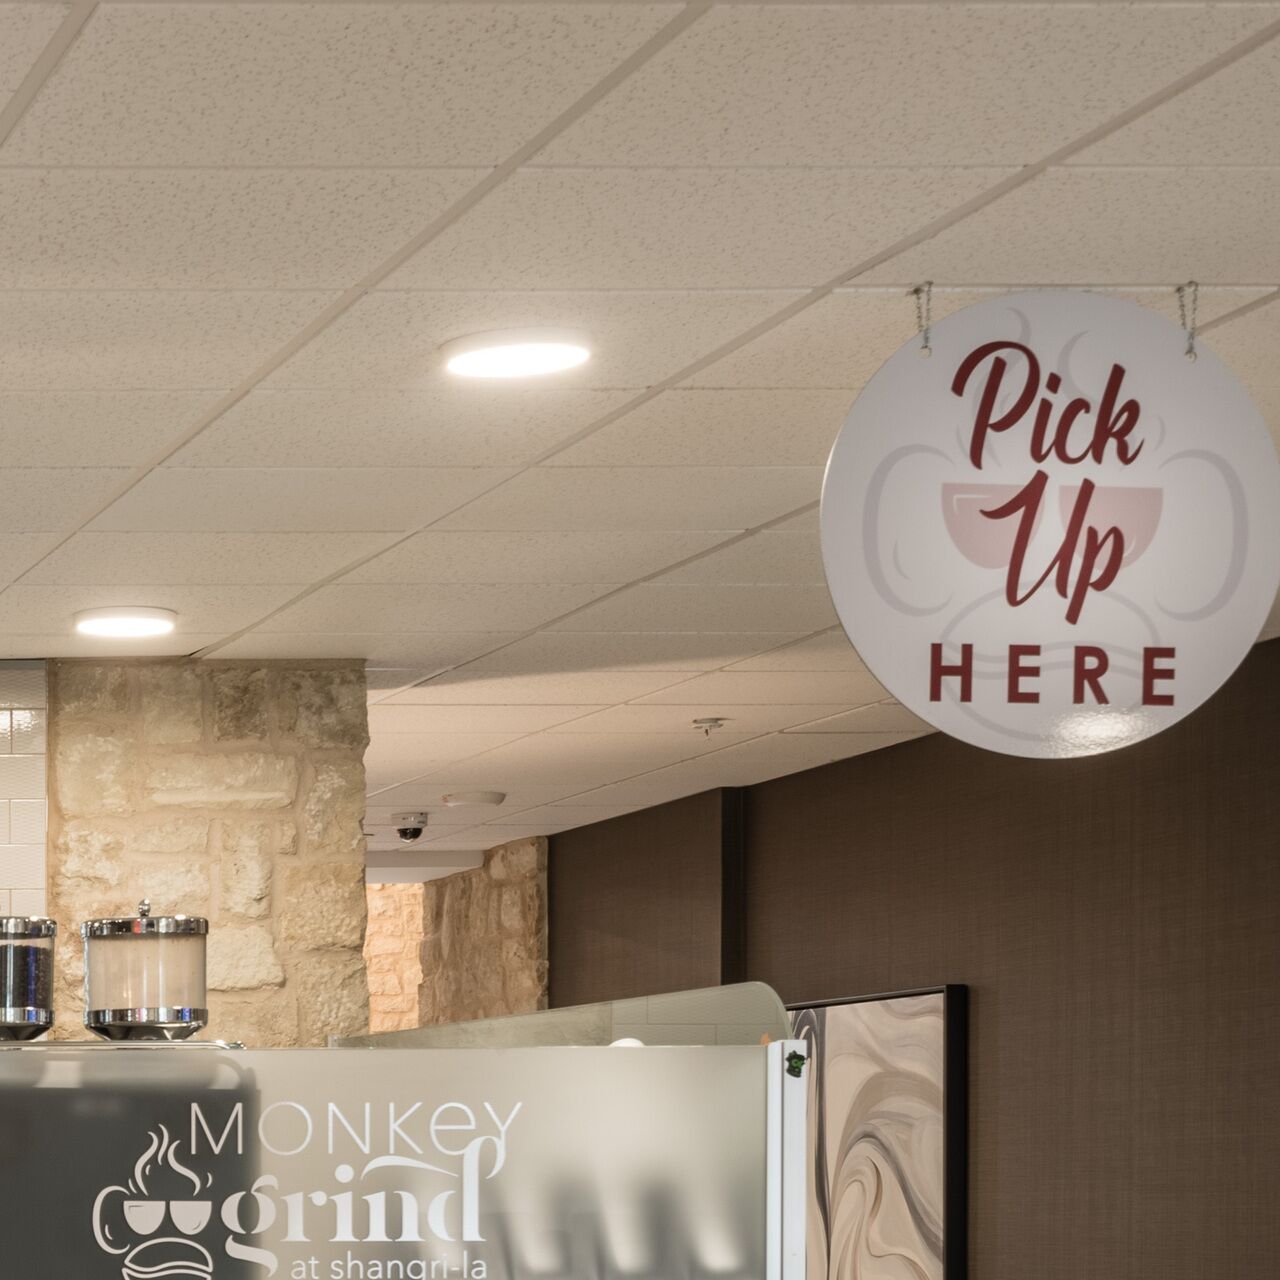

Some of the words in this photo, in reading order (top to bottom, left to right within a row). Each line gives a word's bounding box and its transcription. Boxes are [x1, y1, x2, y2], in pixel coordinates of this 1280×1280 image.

[950, 341, 1144, 470] Pick
[979, 470, 1125, 625] Up
[929, 643, 1175, 706] HERE
[220, 1134, 505, 1277] grind
[290, 1254, 320, 1280] at
